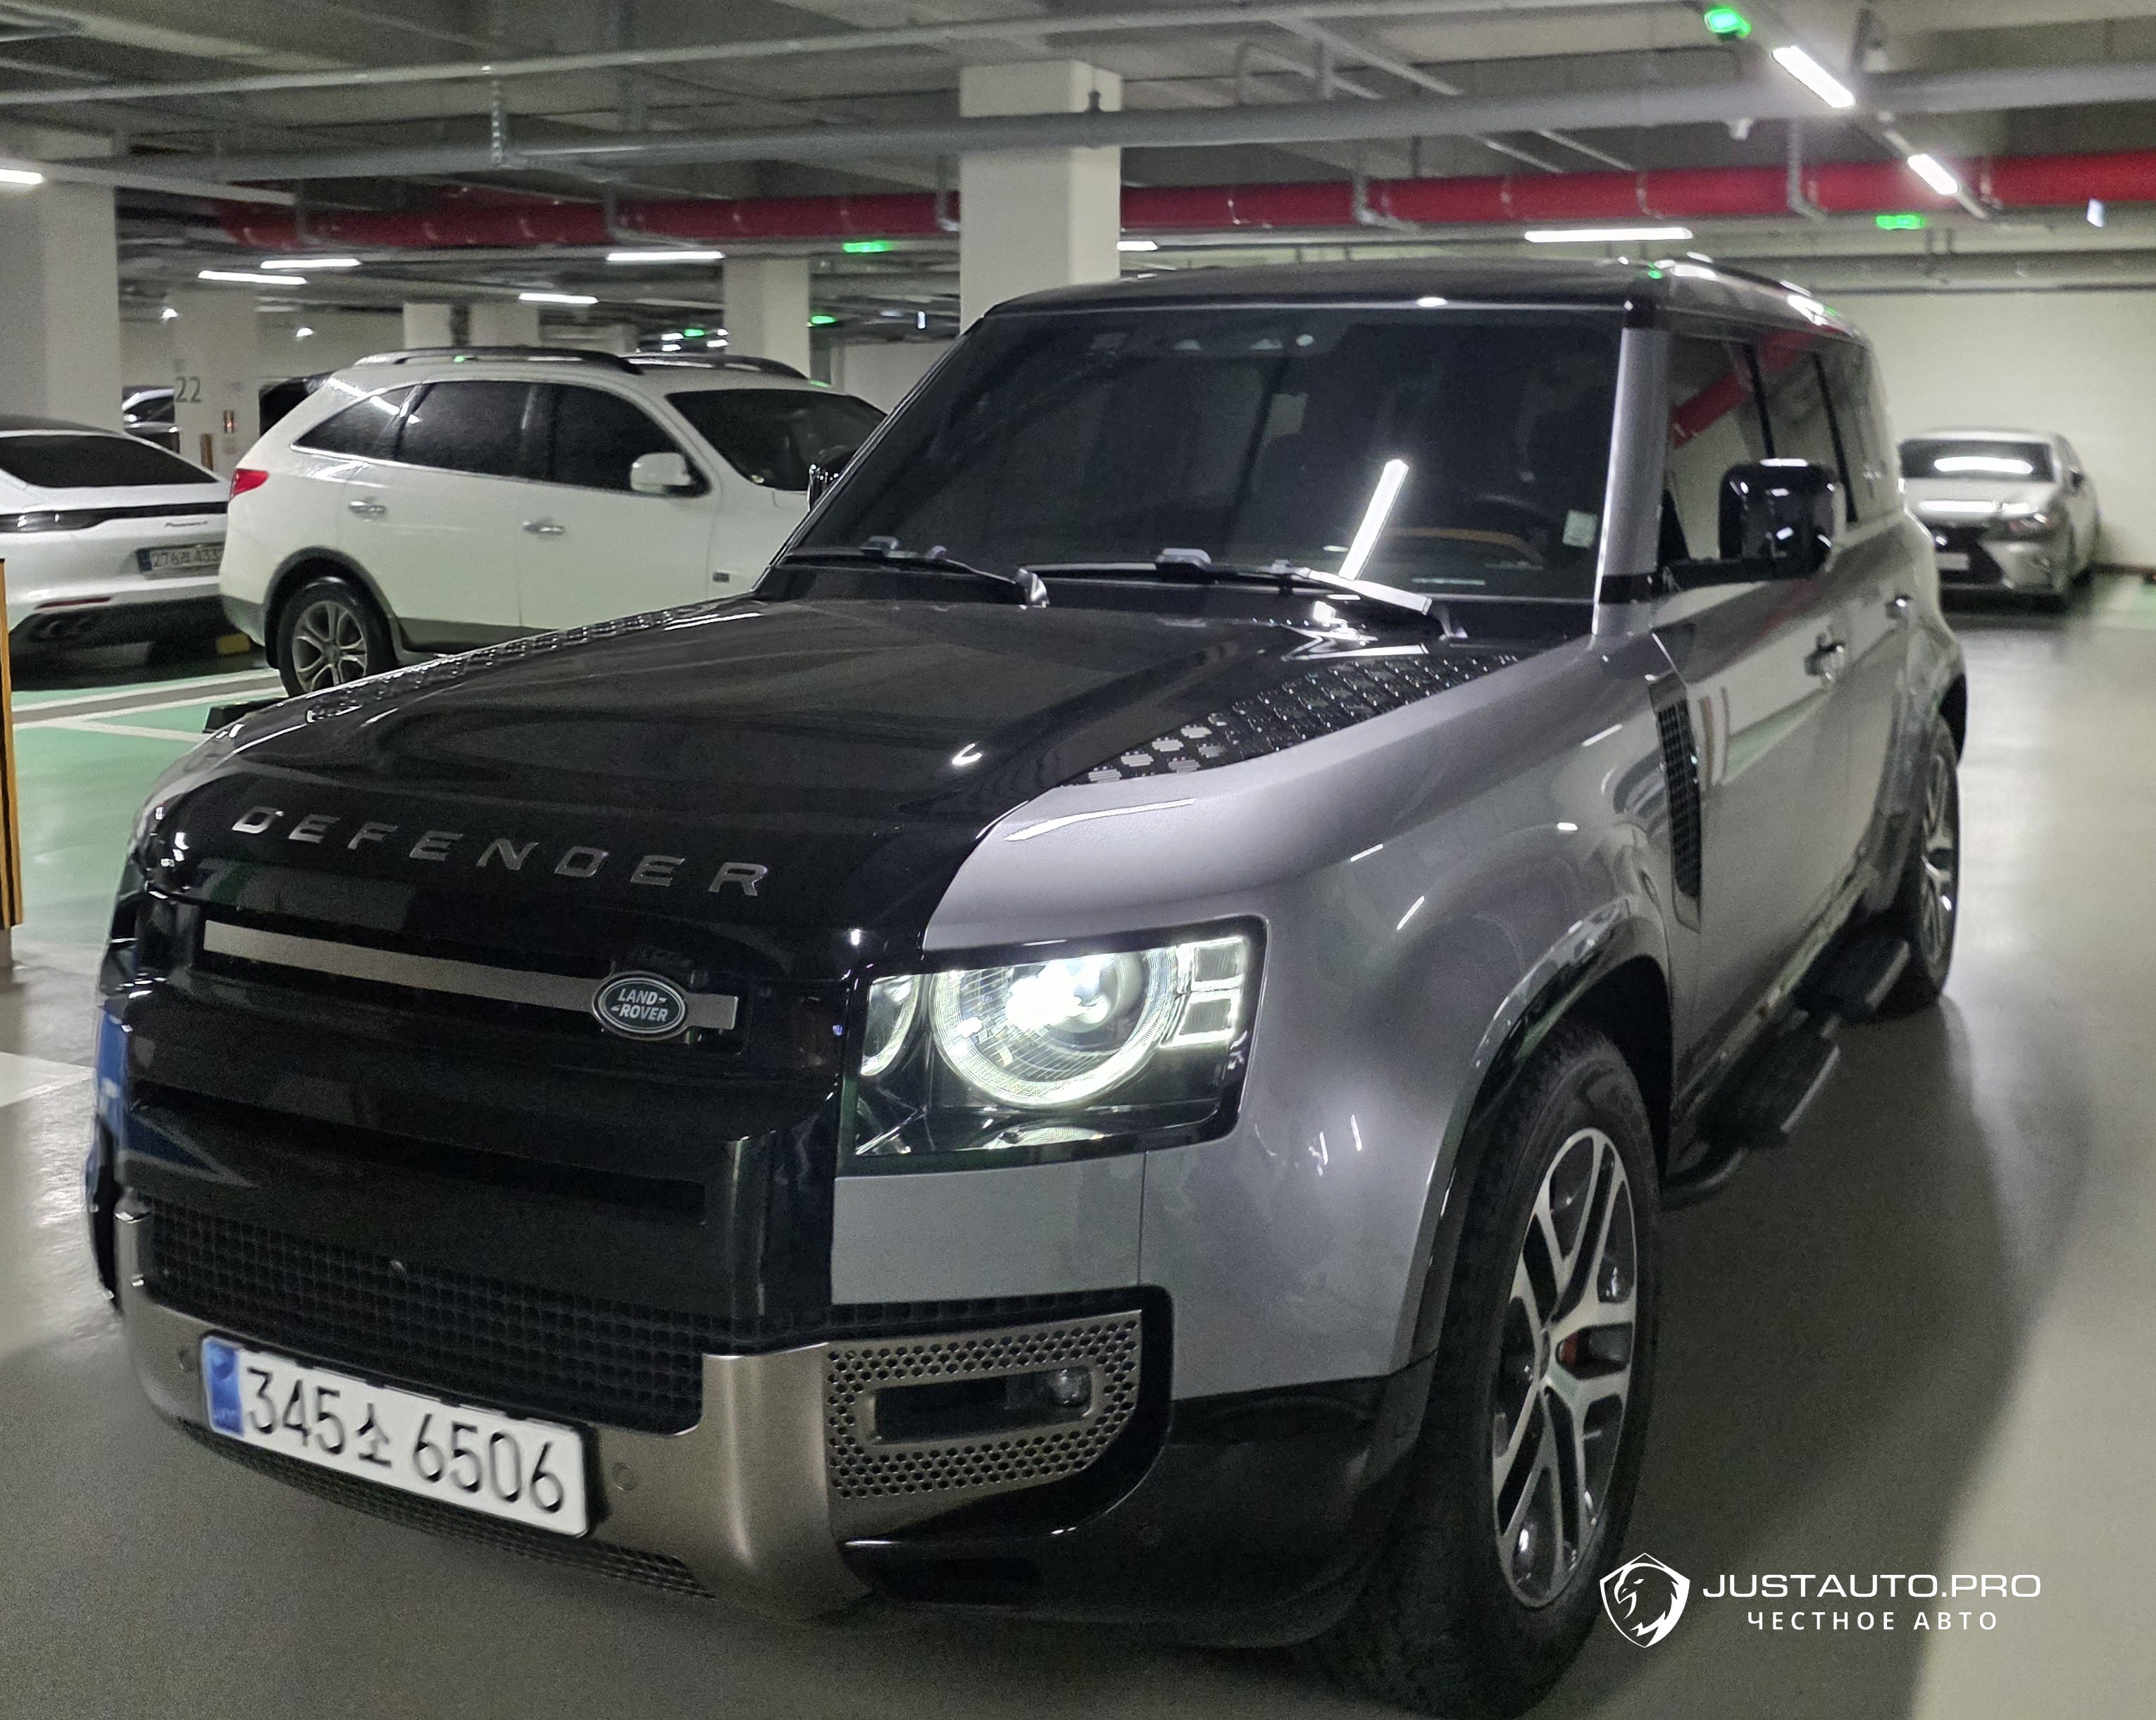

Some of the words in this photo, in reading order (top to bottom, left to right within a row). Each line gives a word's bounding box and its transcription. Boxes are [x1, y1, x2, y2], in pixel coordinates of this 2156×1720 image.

[175, 375, 201, 404] 22
[231, 805, 770, 898] DEFENDER
[247, 1366, 392, 1469] 345소
[412, 1413, 564, 1514] 6506
